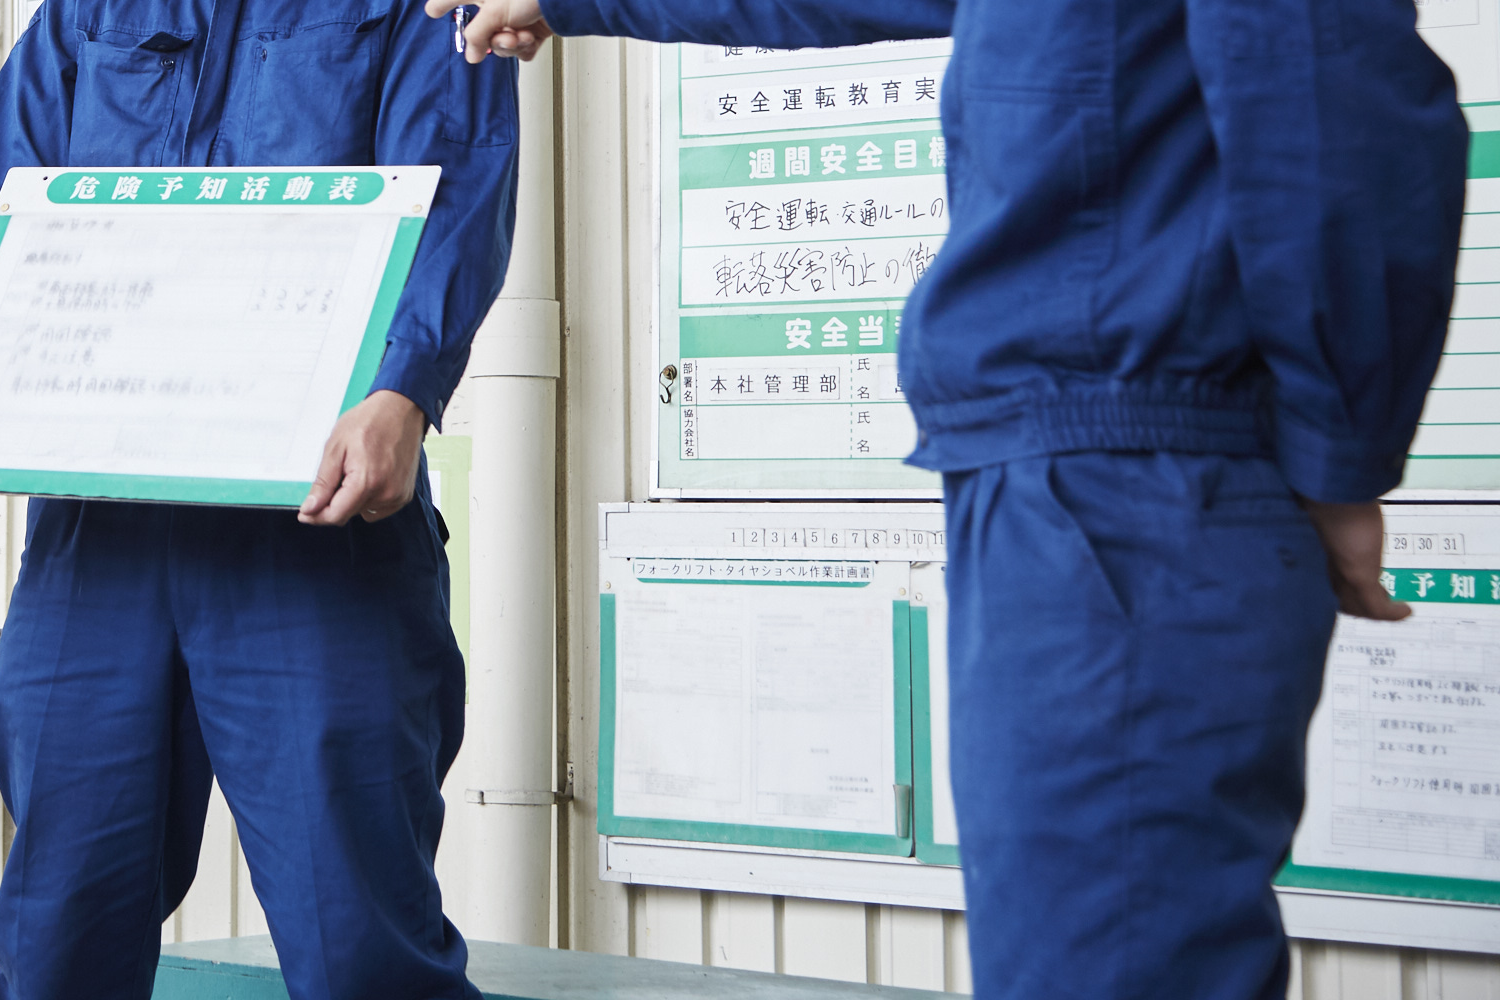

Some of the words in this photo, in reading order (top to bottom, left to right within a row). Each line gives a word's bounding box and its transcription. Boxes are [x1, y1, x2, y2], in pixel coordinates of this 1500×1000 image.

[718, 76, 936, 117] 安全運転教育実
[69, 175, 358, 201] 危険予知活動表
[785, 314, 903, 350] 安全当
[683, 362, 693, 402] 部署名
[710, 373, 837, 395] 本社管理部
[684, 408, 695, 457] 協力会社名
[751, 531, 758, 543] 2
[771, 531, 778, 543] 3
[791, 531, 798, 543] 4
[811, 531, 818, 543] 5
[831, 533, 838, 544] 6
[852, 533, 859, 544] 7
[872, 533, 880, 544] 8
[893, 533, 901, 544] 9
[912, 533, 924, 544] 10
[1394, 537, 1408, 550] 29
[1418, 537, 1433, 550] 30
[1443, 537, 1457, 551] 31
